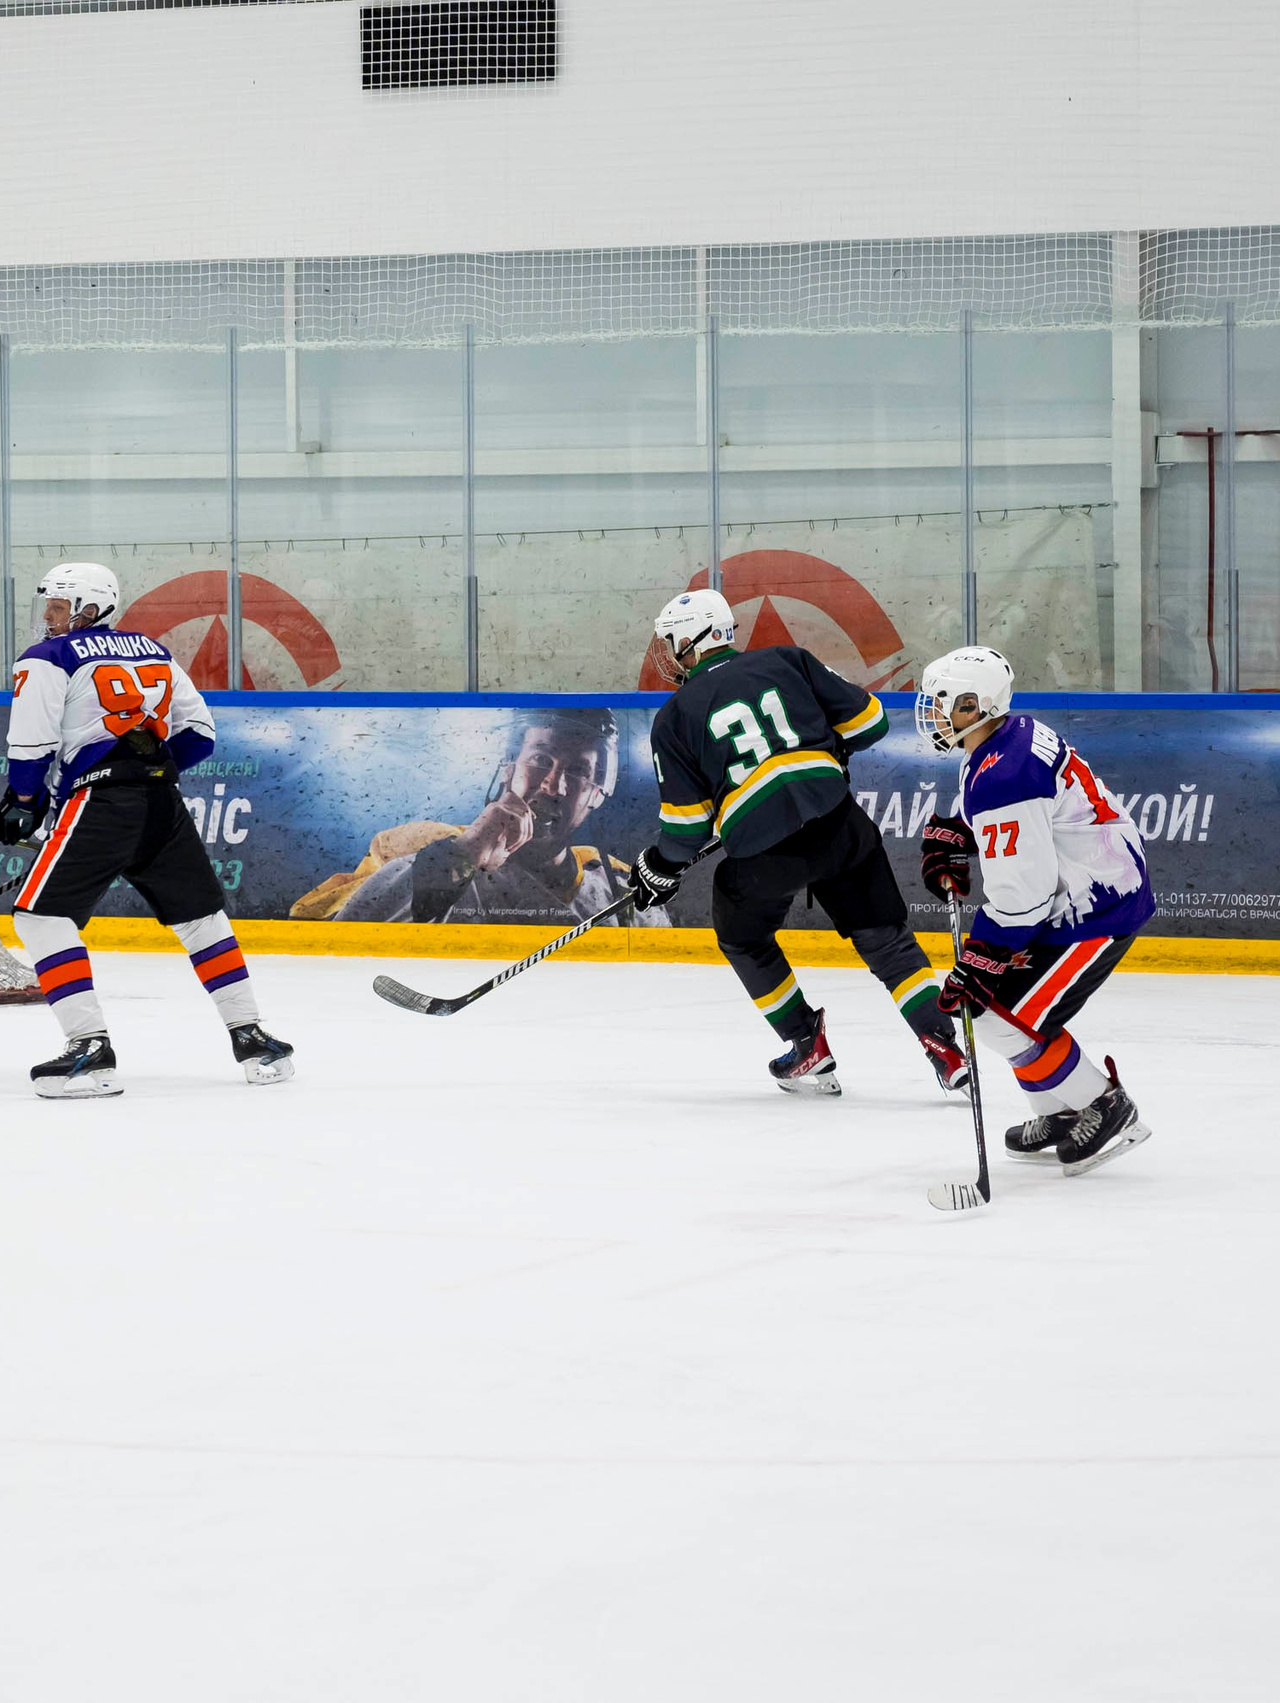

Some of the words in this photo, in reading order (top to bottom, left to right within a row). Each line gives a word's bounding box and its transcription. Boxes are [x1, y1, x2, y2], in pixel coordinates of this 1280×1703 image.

[12, 669, 29, 698] 7
[91, 664, 173, 741] 97
[706, 687, 801, 786] 31
[72, 767, 112, 790] AUER
[922, 825, 967, 848] UER
[982, 820, 1020, 859] 77
[491, 918, 593, 988] WARRIOR
[960, 950, 1007, 975] BAU
[924, 1037, 947, 1054] CCM
[789, 1052, 820, 1079] CCM
